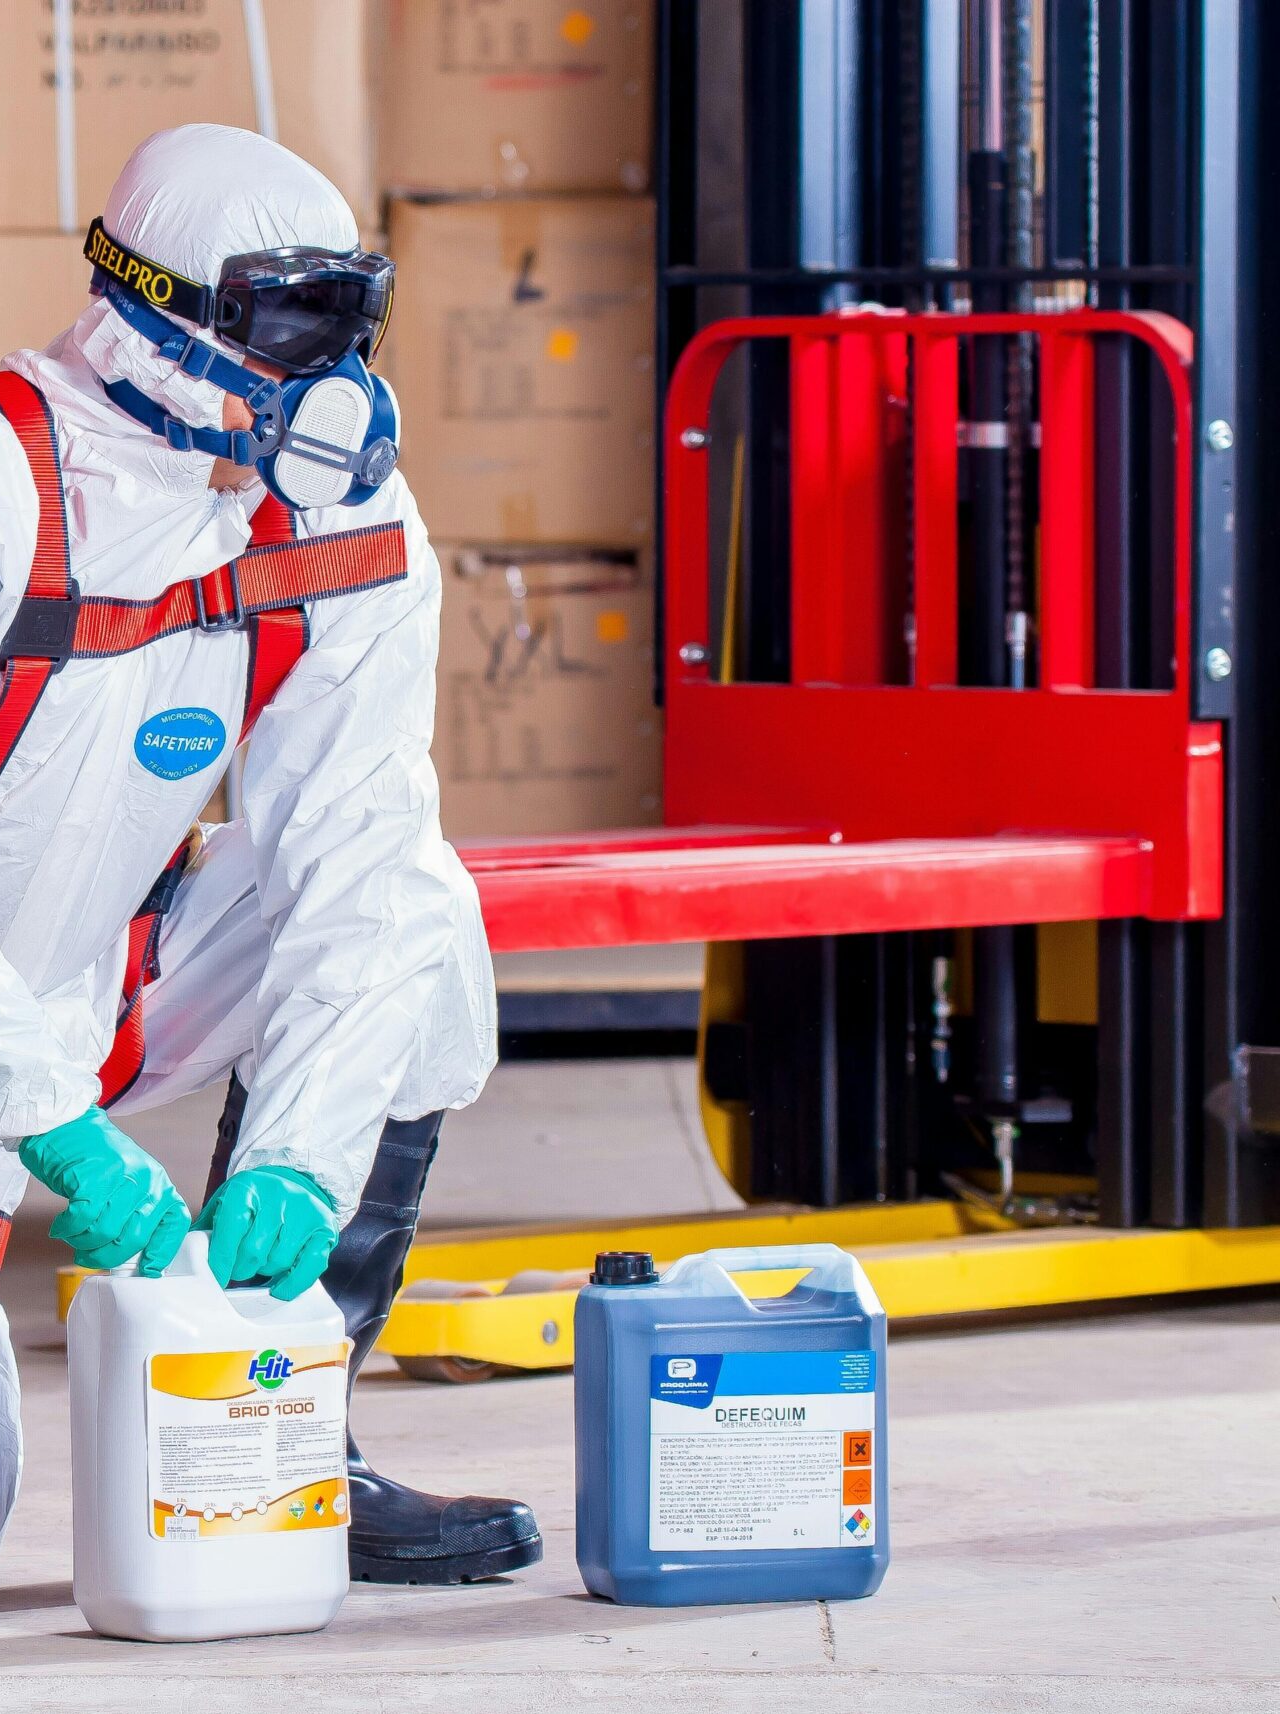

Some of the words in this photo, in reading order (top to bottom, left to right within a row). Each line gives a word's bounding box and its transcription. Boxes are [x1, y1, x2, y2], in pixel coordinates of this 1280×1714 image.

[88, 227, 173, 307] STEELPRO
[160, 712, 215, 726] MICROPOROUS
[146, 760, 199, 778] TECHNOLOGY
[248, 1353, 294, 1380] Hit
[229, 1405, 269, 1419] BRIO
[274, 1402, 315, 1415] 1000
[715, 1407, 806, 1422] DEFEQUIM
